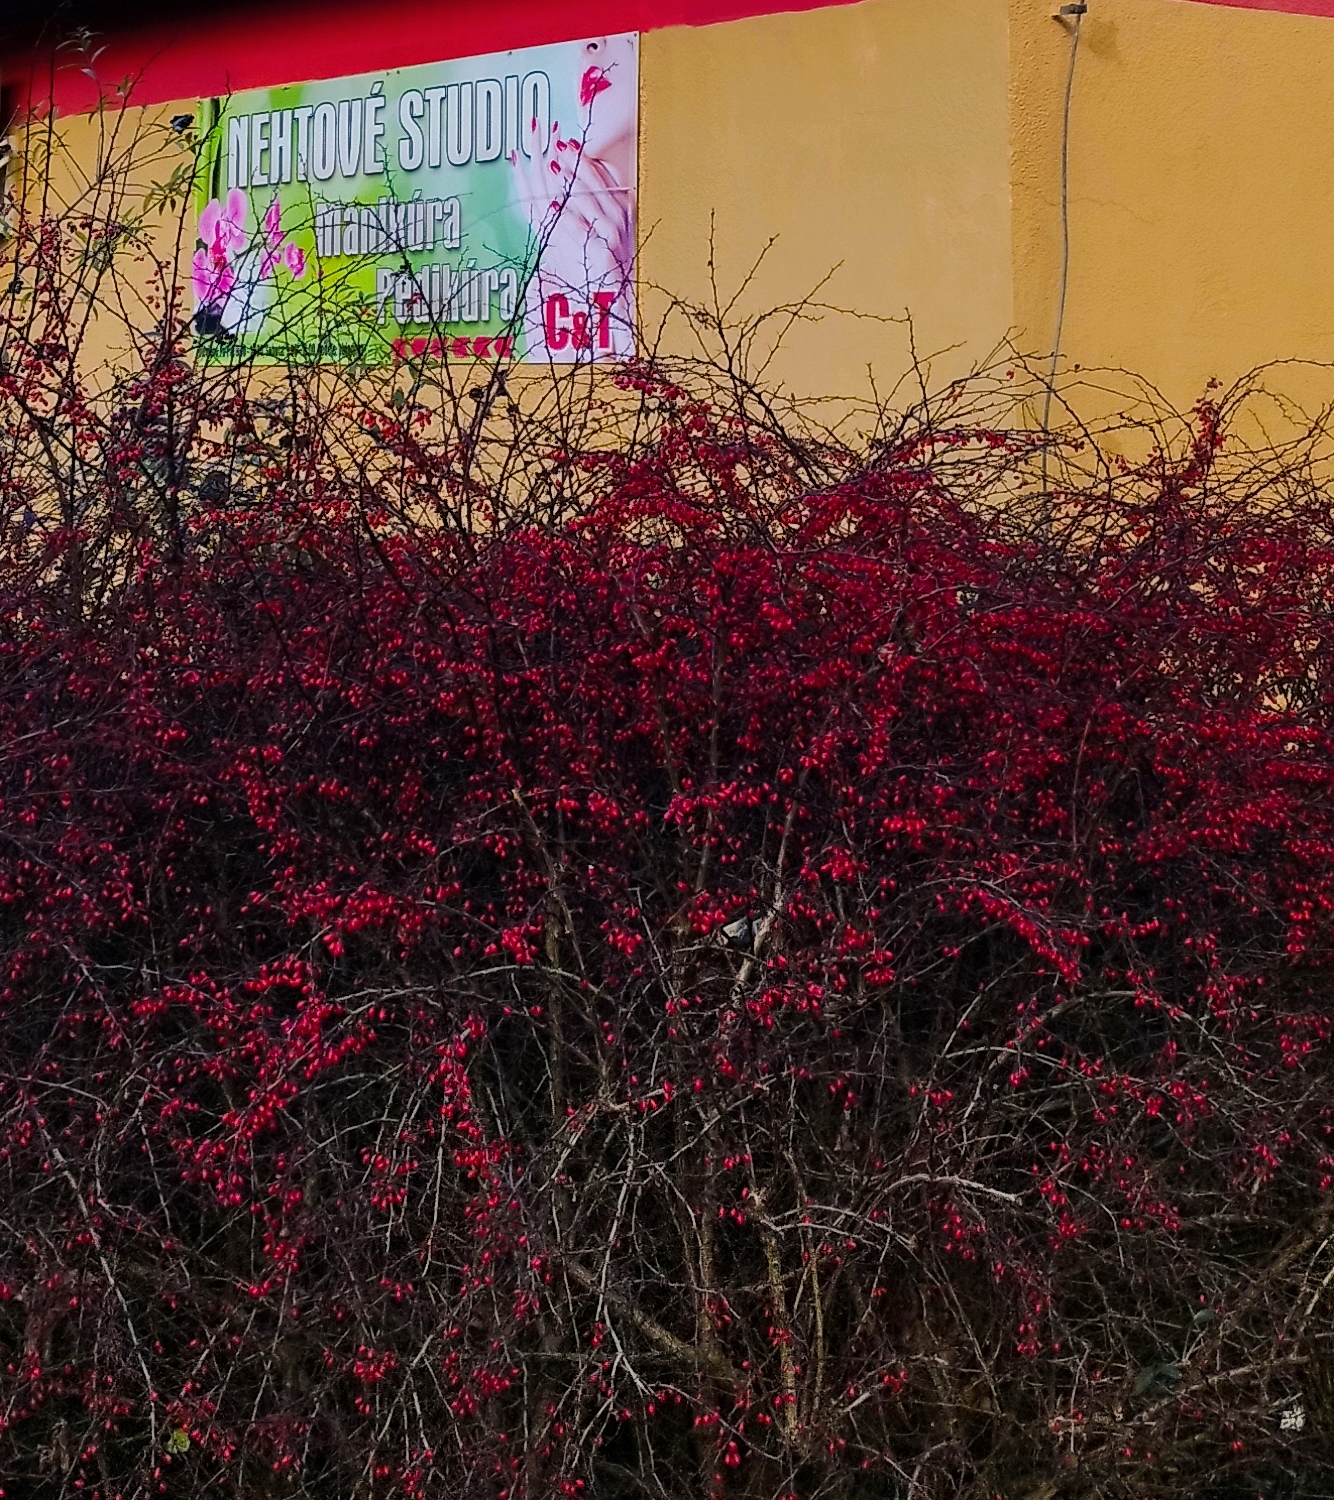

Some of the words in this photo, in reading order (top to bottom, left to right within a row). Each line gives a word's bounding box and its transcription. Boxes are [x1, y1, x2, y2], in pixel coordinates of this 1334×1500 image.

[227, 80, 385, 189] NEHTOVÉ
[398, 70, 551, 173] STUDIO
[375, 258, 519, 326] Pedikúra
[546, 291, 616, 351] C&T
